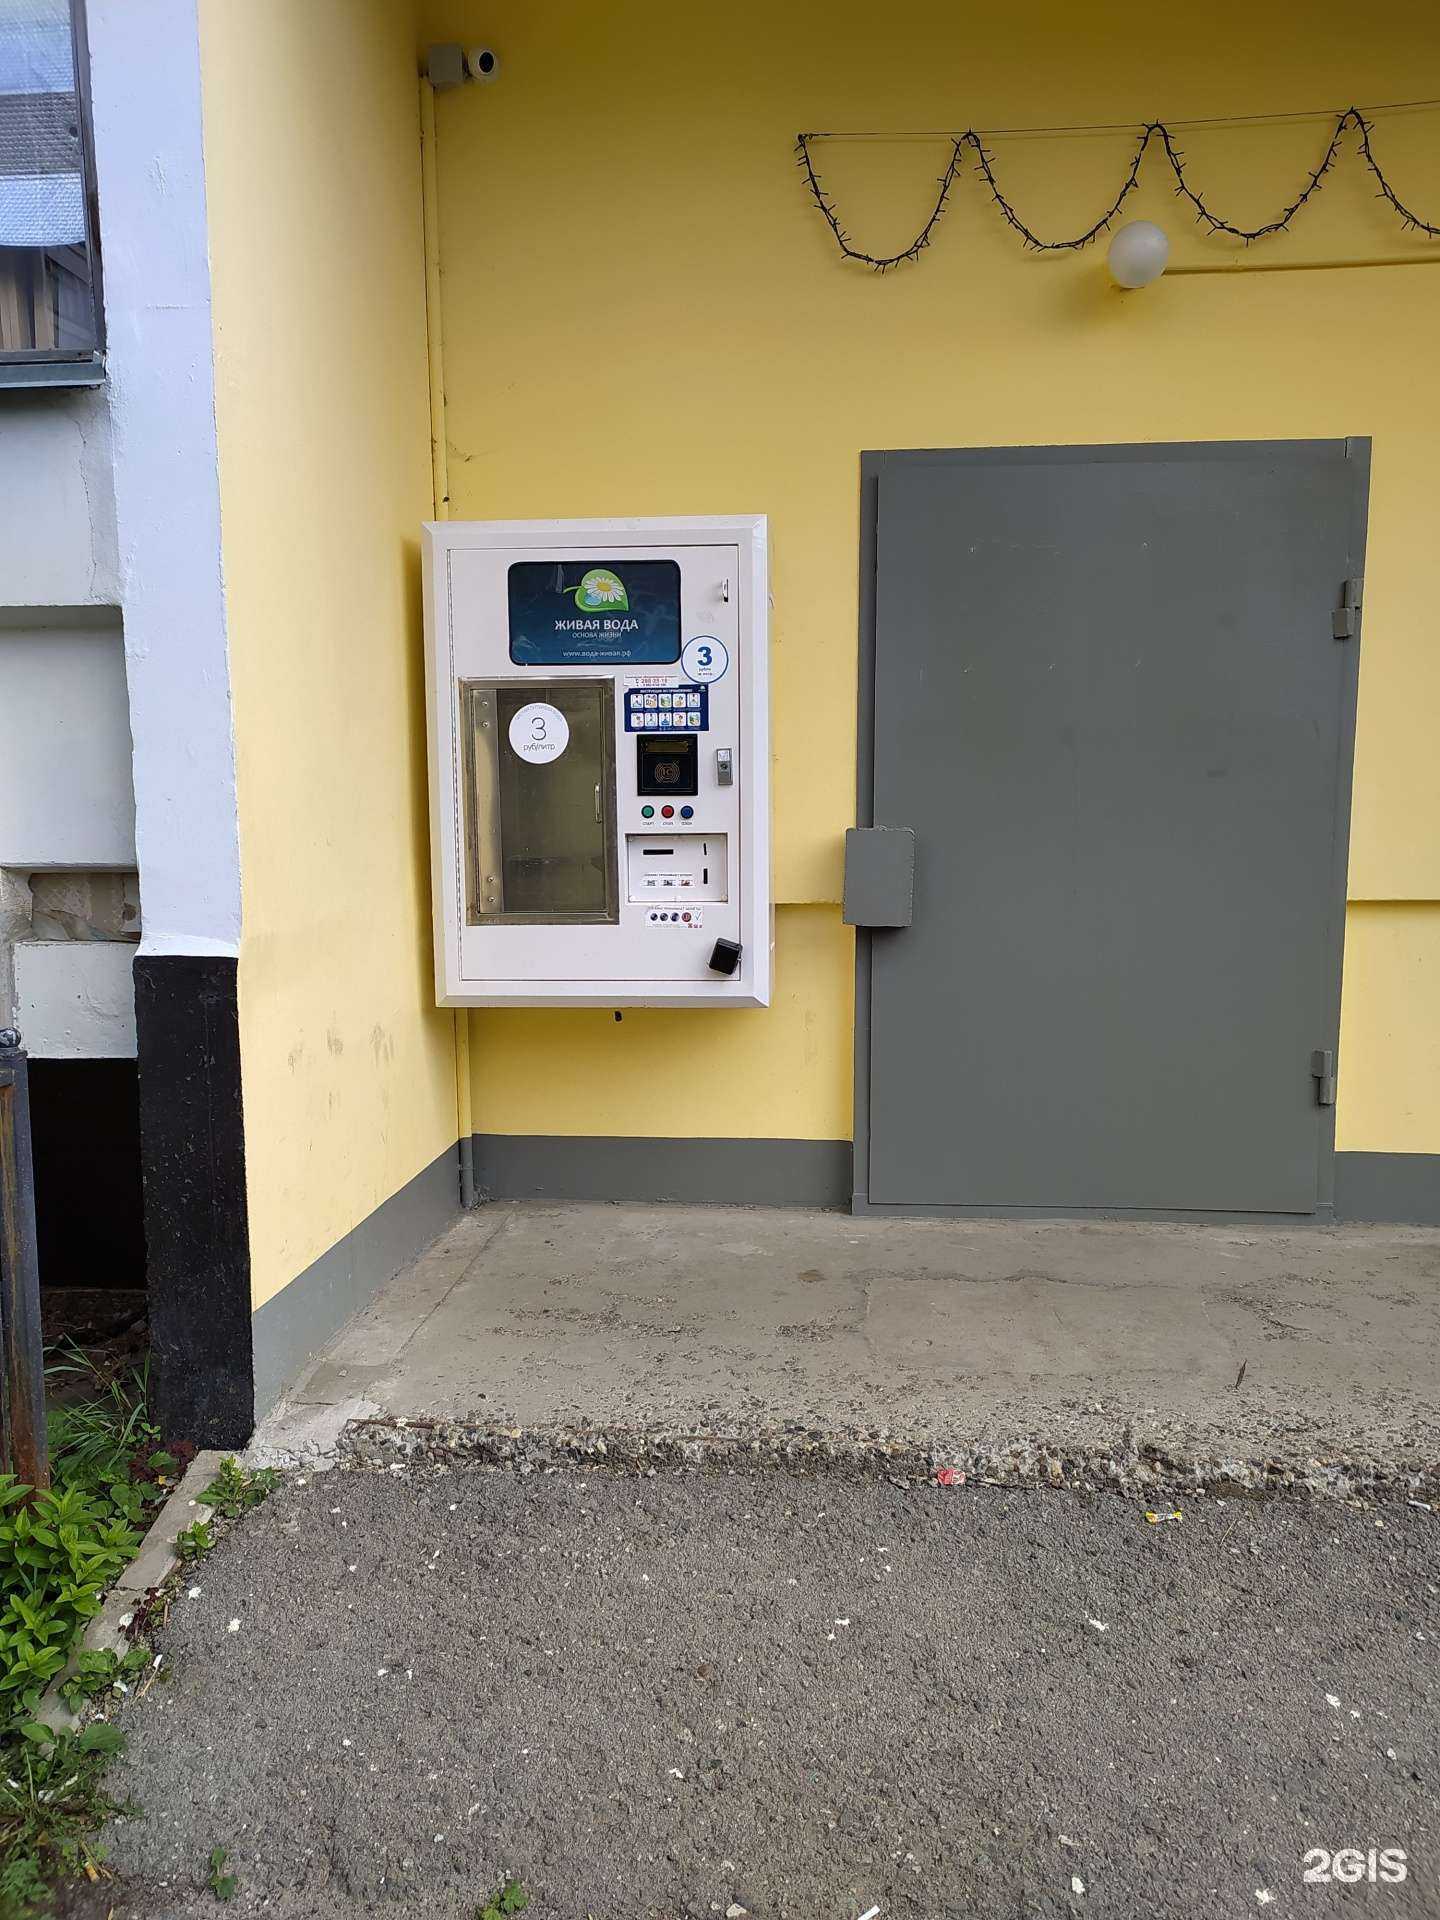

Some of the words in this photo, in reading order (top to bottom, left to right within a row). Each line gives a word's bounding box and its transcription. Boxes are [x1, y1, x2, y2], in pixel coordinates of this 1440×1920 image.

[554, 619, 600, 631] ЖИВАЯ
[603, 619, 639, 632] ВОДА
[572, 631, 598, 639] ОСНОВА
[599, 631, 622, 639] ЖИЗНИ
[697, 646, 713, 667] 3
[531, 716, 547, 741] 3
[523, 742, 556, 752] руб/литр
